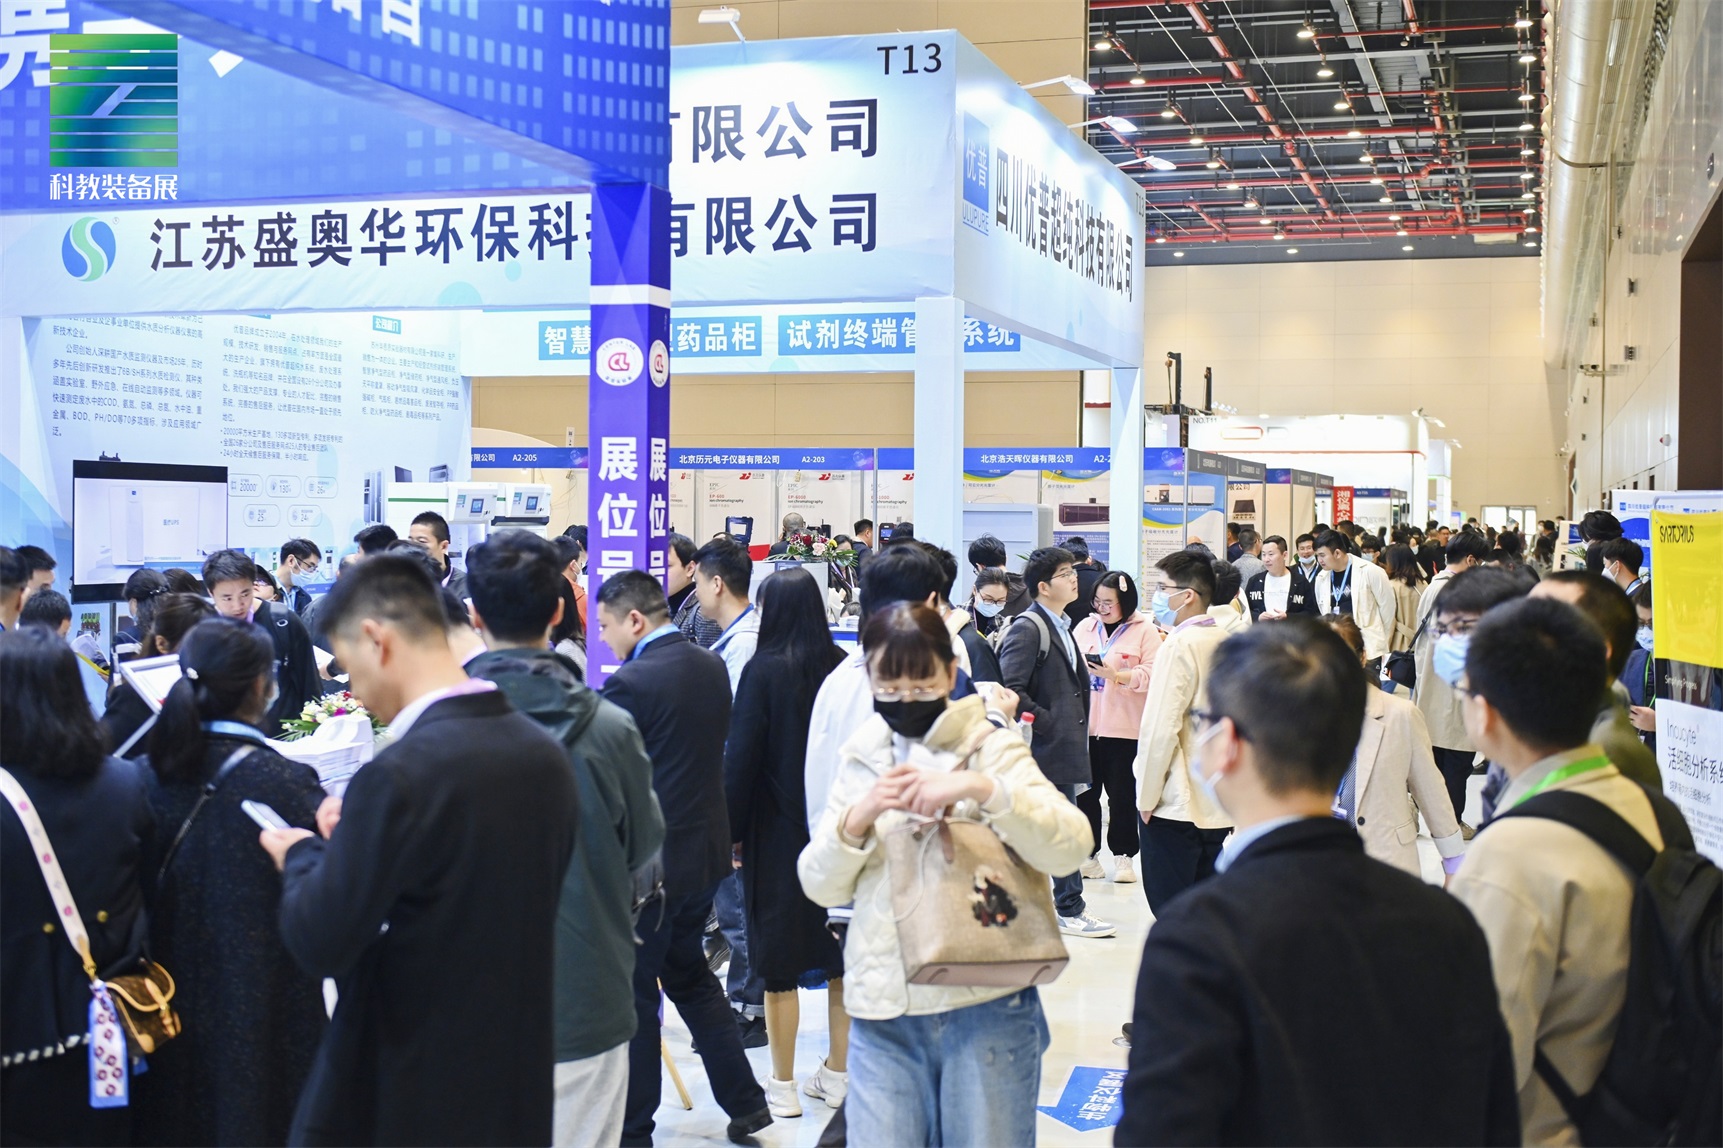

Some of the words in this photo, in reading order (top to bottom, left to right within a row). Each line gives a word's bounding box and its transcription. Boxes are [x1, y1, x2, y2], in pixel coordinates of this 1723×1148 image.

[877, 43, 942, 75] T13
[670, 98, 879, 164] 限公司
[964, 137, 989, 191] 优普
[995, 146, 1134, 303] 四川优普超纯科技有限公司
[787, 317, 1015, 350] 试剂终端管系统
[512, 453, 537, 462] A2-205
[679, 454, 780, 465] 北京历元电子仪器有限公司
[801, 455, 826, 463] A2-203
[980, 453, 1074, 464] 北京浩天晖仪器有限公司
[1659, 525, 1695, 544] SARTORIUS
